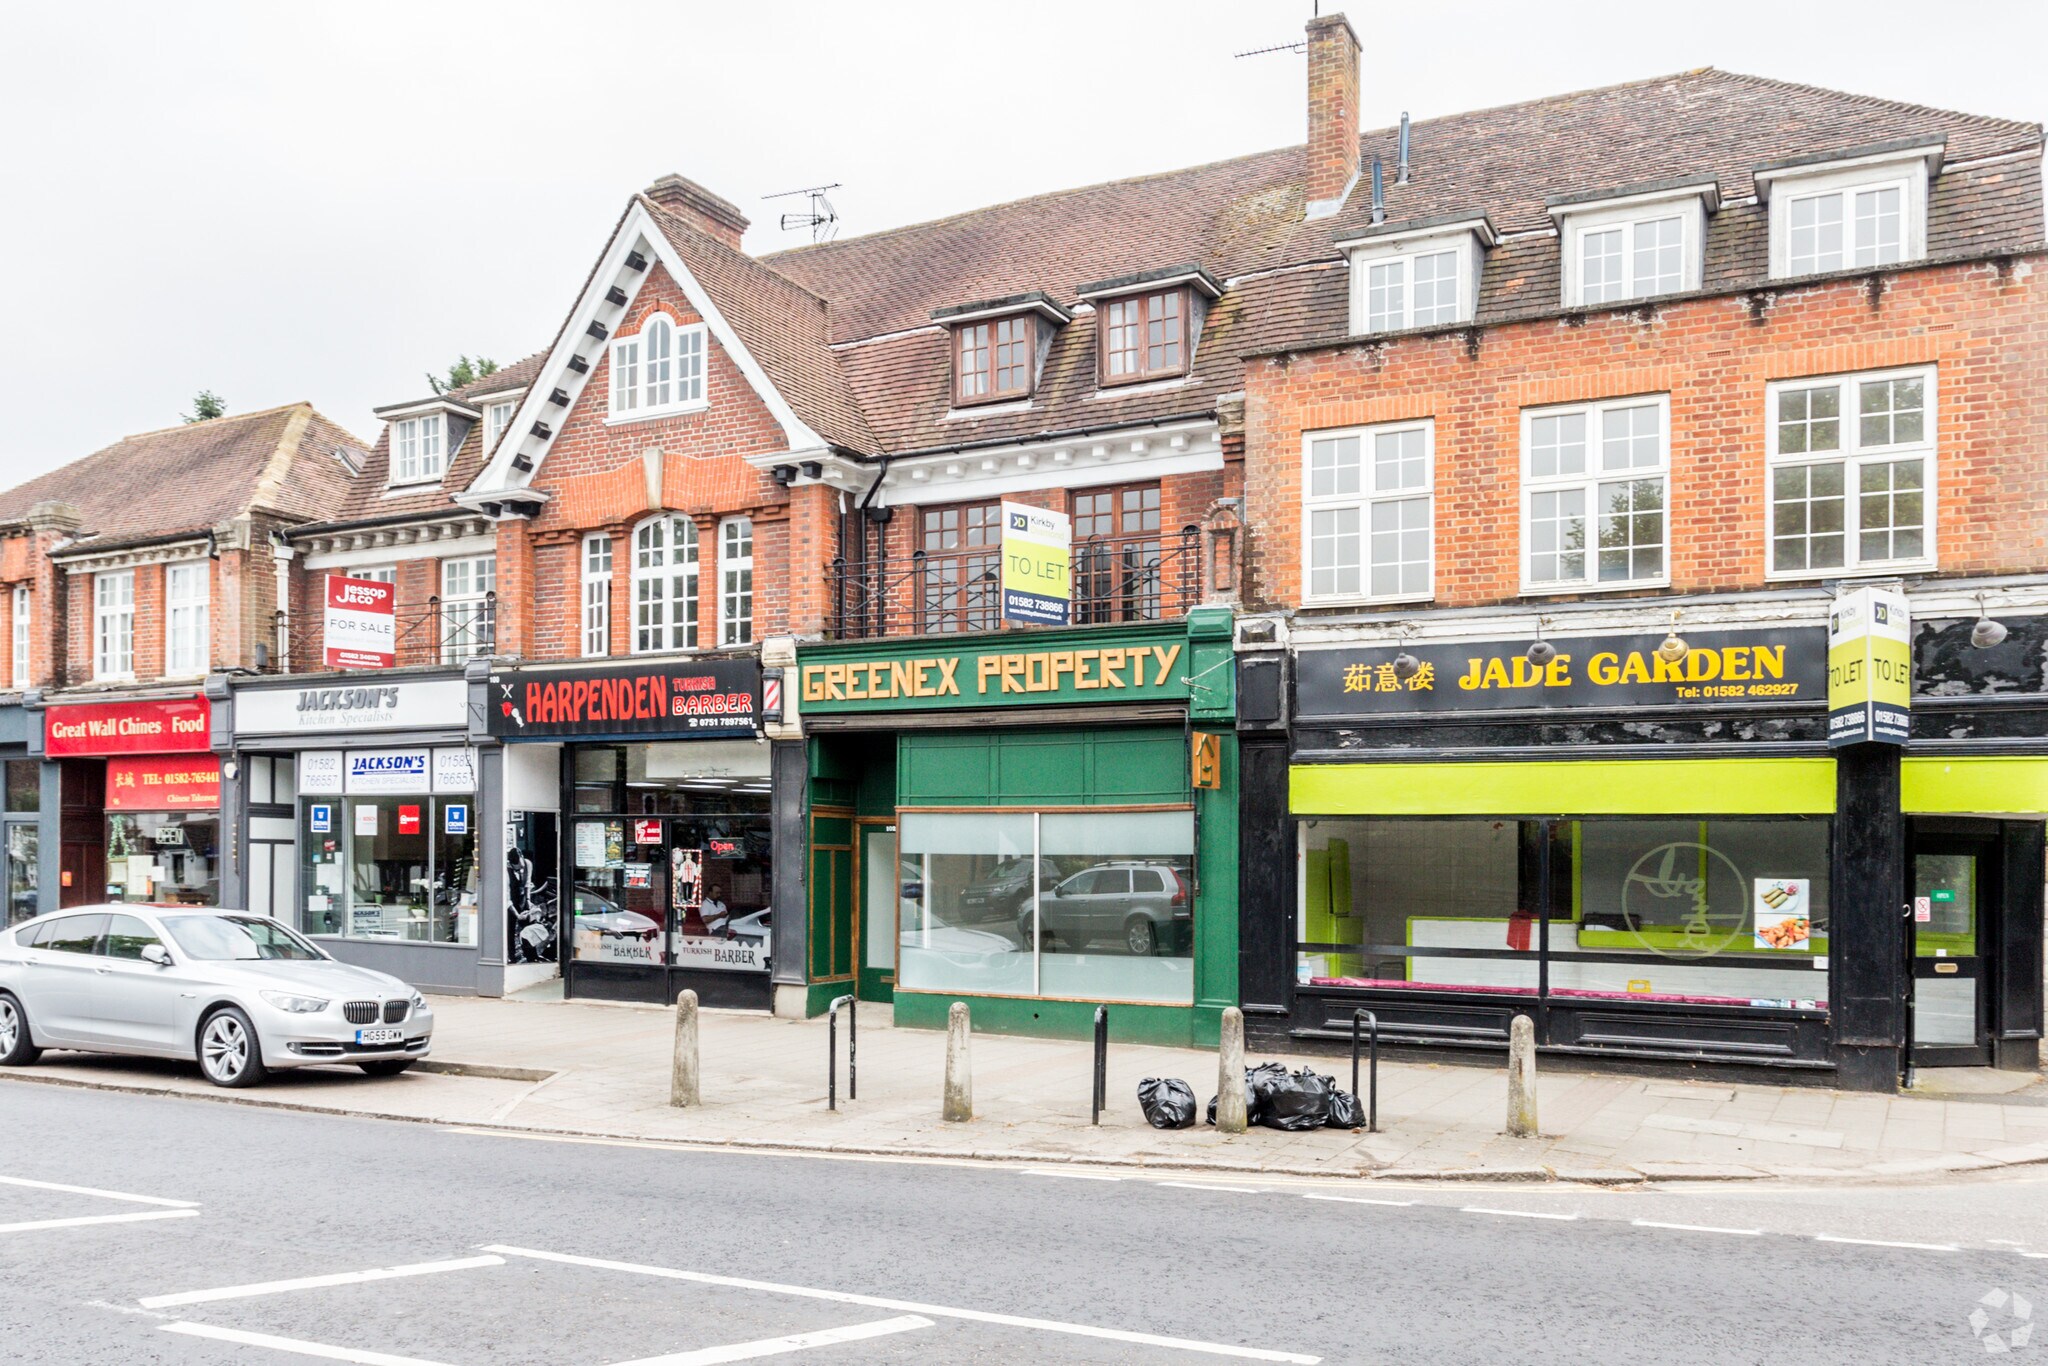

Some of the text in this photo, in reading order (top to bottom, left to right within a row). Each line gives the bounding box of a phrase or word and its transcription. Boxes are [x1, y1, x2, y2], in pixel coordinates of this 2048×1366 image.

[1030, 515, 1056, 531] Kirkby
[1009, 555, 1065, 581] TO LET
[1008, 594, 1034, 609] 01582
[330, 618, 391, 634] FOR SALE
[803, 644, 1183, 702] GREENEX PROPERTY
[1458, 644, 1787, 690] JADE GARDEN
[1831, 659, 1863, 689] TO LET
[1874, 658, 1891, 680] TO
[296, 686, 400, 711] JACKSON'S
[1676, 683, 1799, 698] Tel: 01582 462927
[525, 674, 717, 724] HARPENDEN TURKISH
[672, 692, 754, 716] BARBER
[52, 713, 205, 739] Great Wall Chines Food
[298, 710, 394, 727] Kitchen Specialists
[307, 758, 336, 771] 01582
[352, 755, 426, 771] JACKSON'S
[440, 754, 472, 768] 01582
[142, 773, 163, 785] TEL:
[305, 774, 338, 788] 766557
[710, 840, 735, 855] Open
[682, 947, 756, 967] TURKISH BARBER
[363, 1030, 386, 1041] HG59
